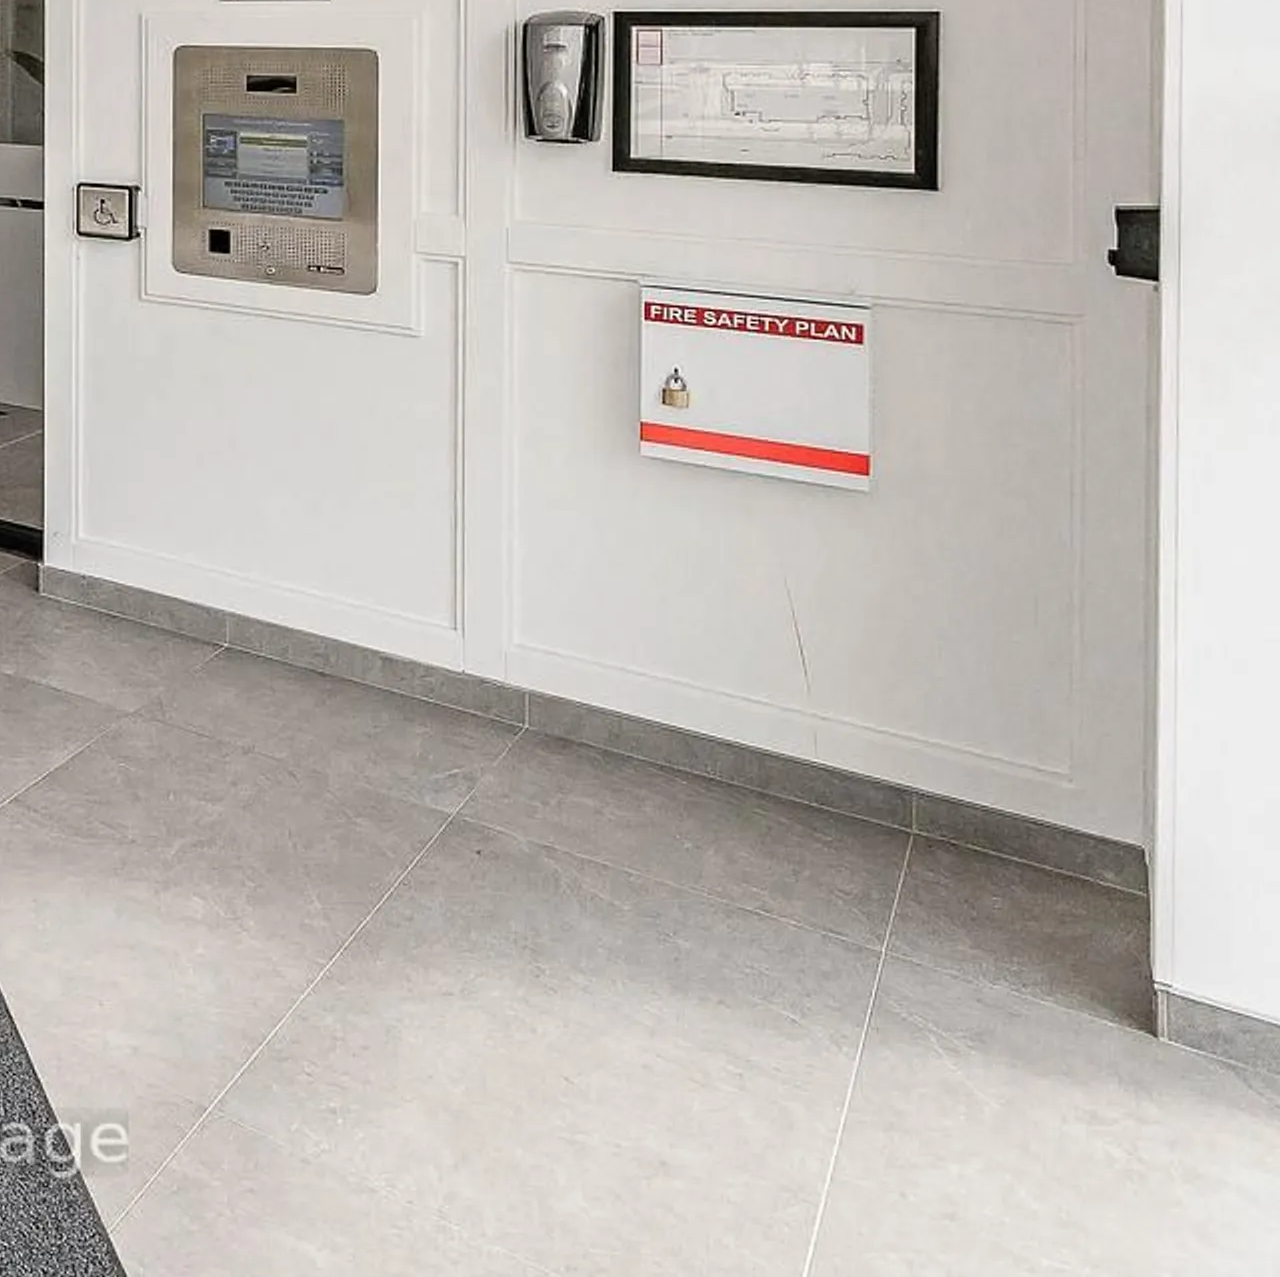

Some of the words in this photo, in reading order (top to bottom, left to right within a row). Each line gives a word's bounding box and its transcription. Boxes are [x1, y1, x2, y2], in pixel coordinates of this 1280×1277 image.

[649, 304, 697, 324] FIRE
[703, 310, 789, 333] SAFETY
[795, 320, 856, 341] PLAN
